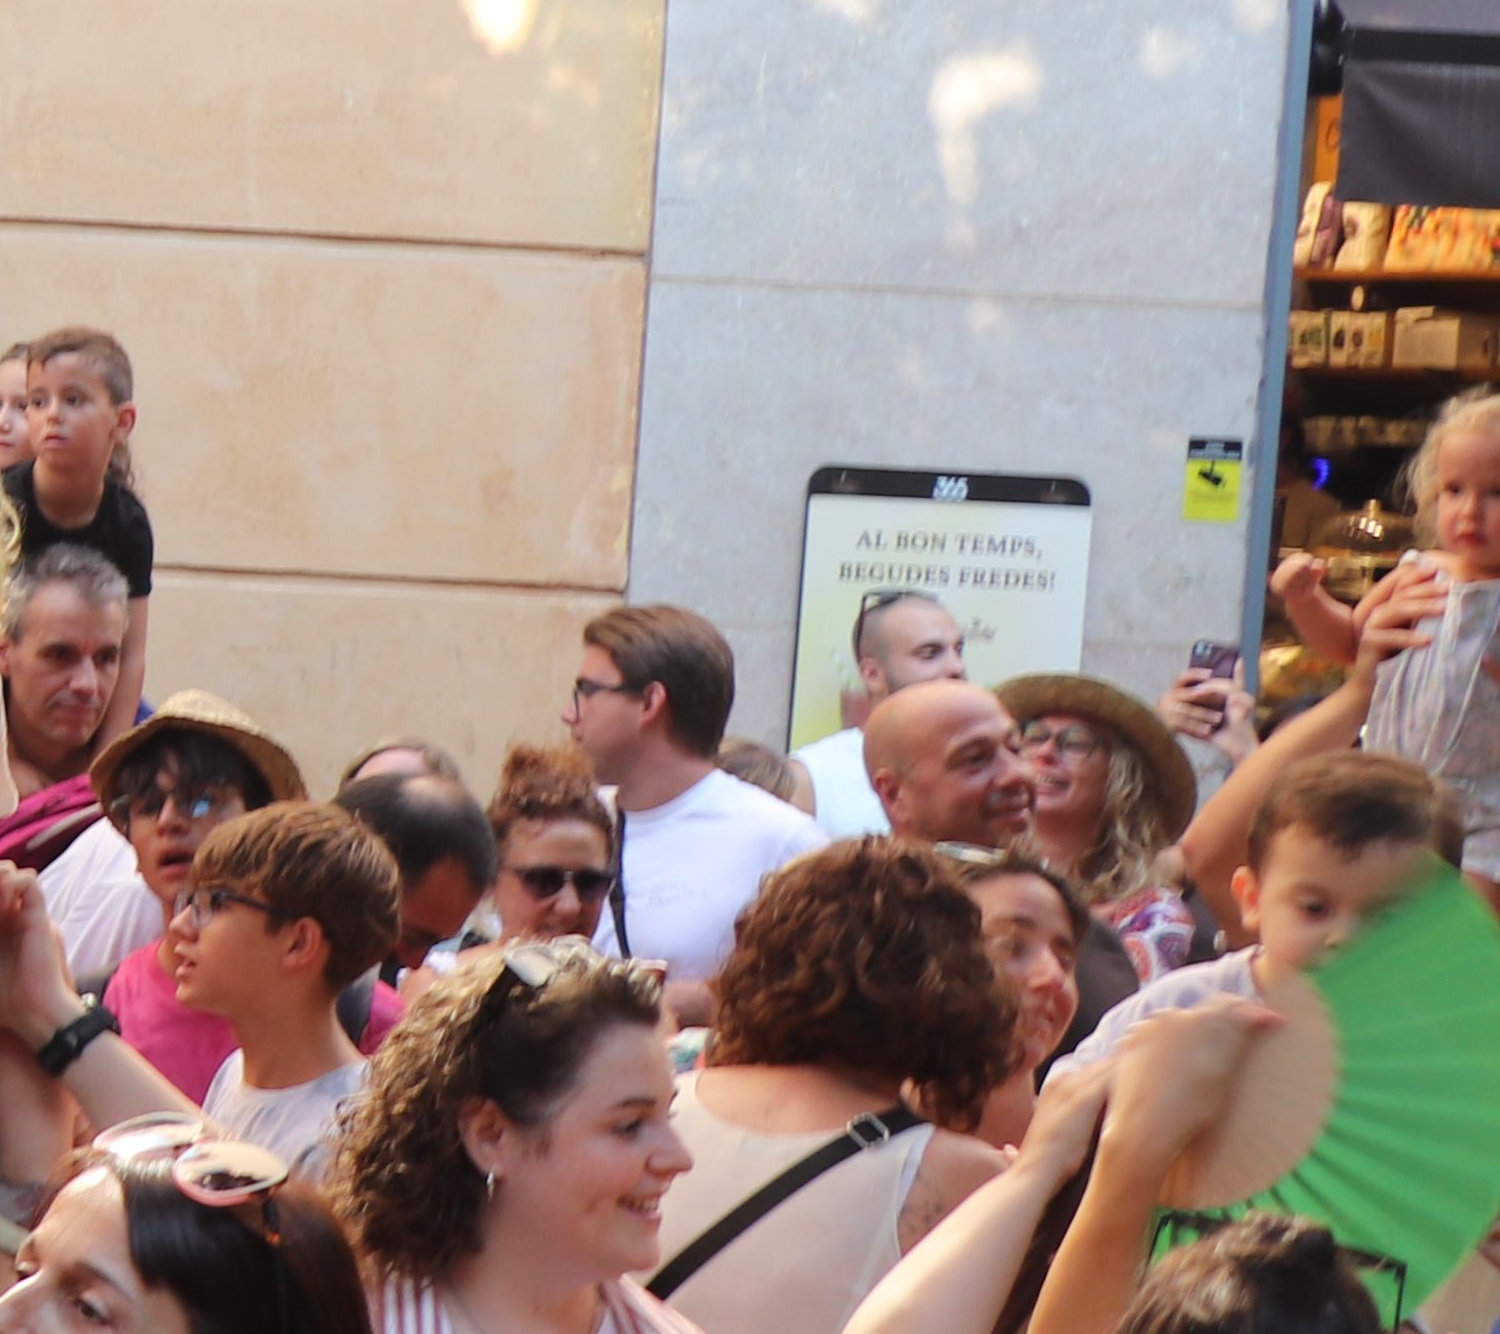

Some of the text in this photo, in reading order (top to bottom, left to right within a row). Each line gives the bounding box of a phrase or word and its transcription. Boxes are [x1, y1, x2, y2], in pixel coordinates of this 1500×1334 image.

[931, 475, 970, 503] 365
[856, 529, 1043, 561] AL BON TEMPS,
[839, 562, 1057, 593] BEGUDES FREDES!
